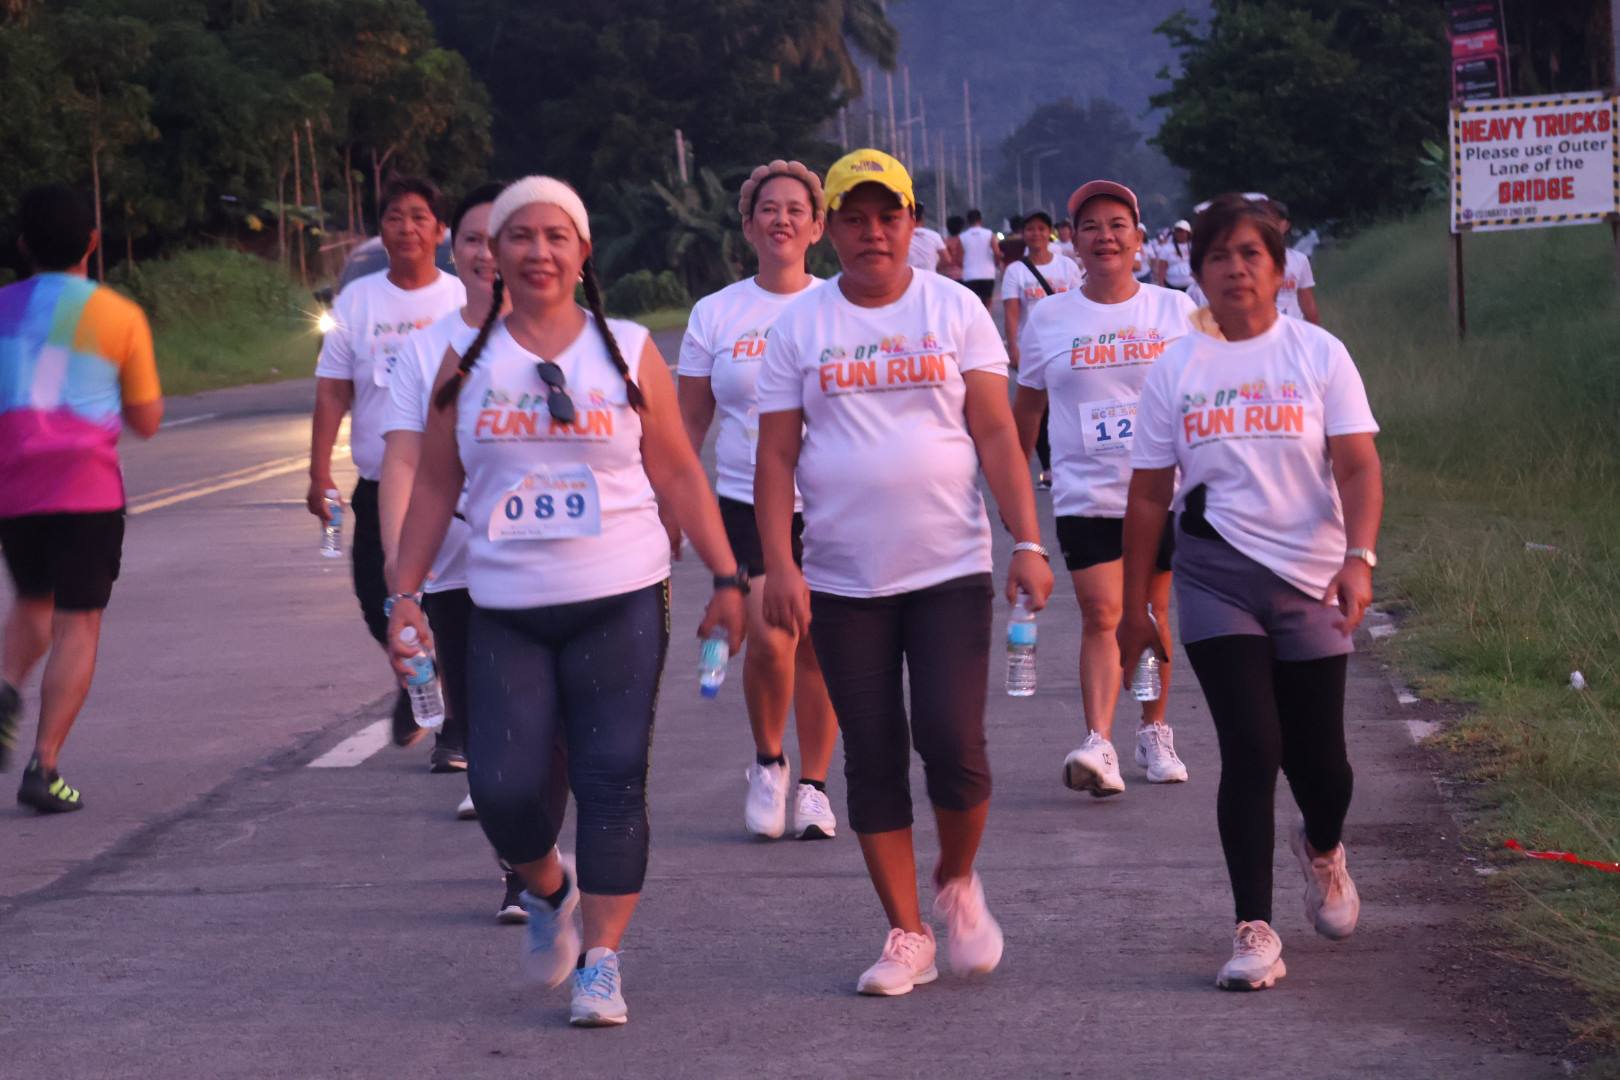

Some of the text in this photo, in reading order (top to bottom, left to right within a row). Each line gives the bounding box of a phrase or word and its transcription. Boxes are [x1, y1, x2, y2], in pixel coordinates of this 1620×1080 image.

[1461, 110, 1611, 143] HEAVY TRUCKS
[1466, 140, 1607, 161] Please use Outer
[1490, 157, 1584, 176] Lane of the
[1498, 176, 1575, 204] BRIDGE
[732, 338, 767, 359] FU
[1071, 344, 1117, 367] FUN
[819, 360, 877, 392] FUN
[887, 354, 946, 385] RUN
[475, 410, 539, 437] FUN
[1183, 407, 1235, 444] FUN
[1244, 404, 1304, 433] RUN
[505, 493, 585, 520] 089
